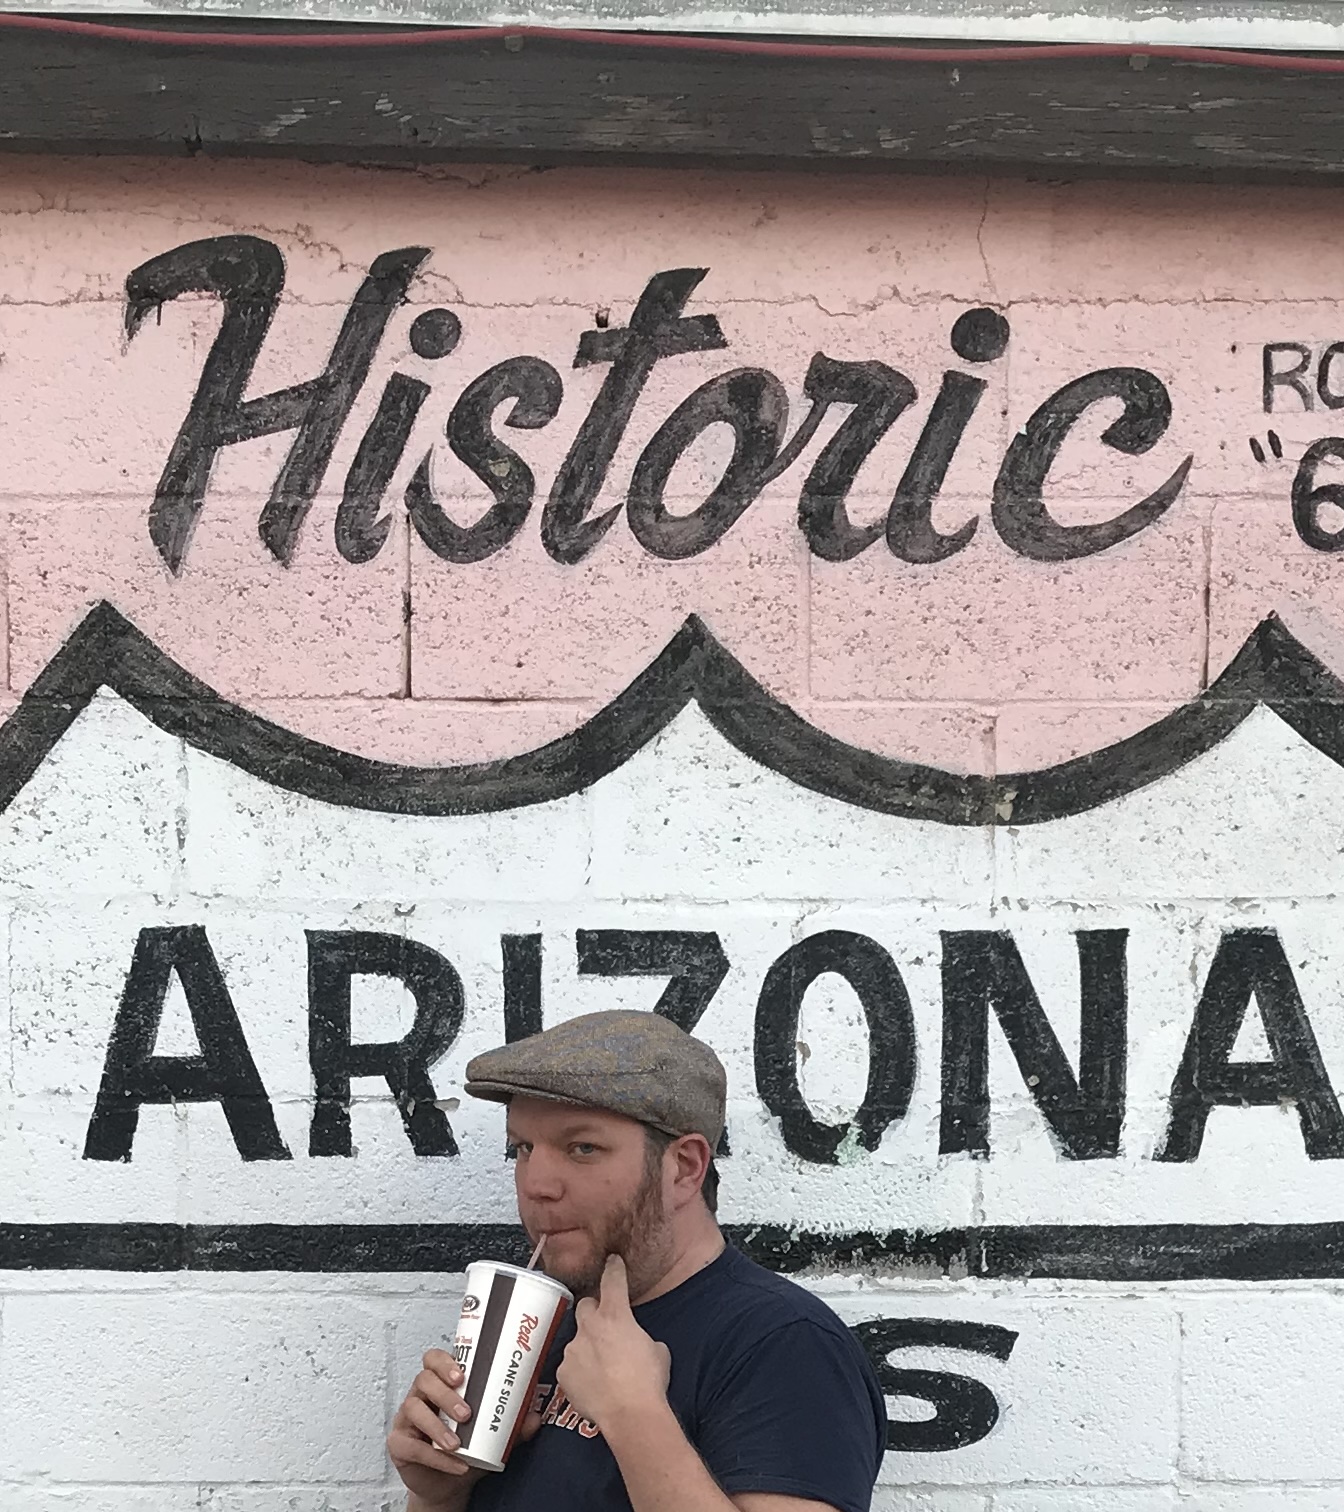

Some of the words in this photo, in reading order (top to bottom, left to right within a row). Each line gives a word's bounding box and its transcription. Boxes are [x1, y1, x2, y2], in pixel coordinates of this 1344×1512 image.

[122, 234, 1194, 579] Historic
[516, 1312, 539, 1352] Real
[503, 1350, 523, 1387] CANE
[488, 1388, 511, 1432] SUGAR
